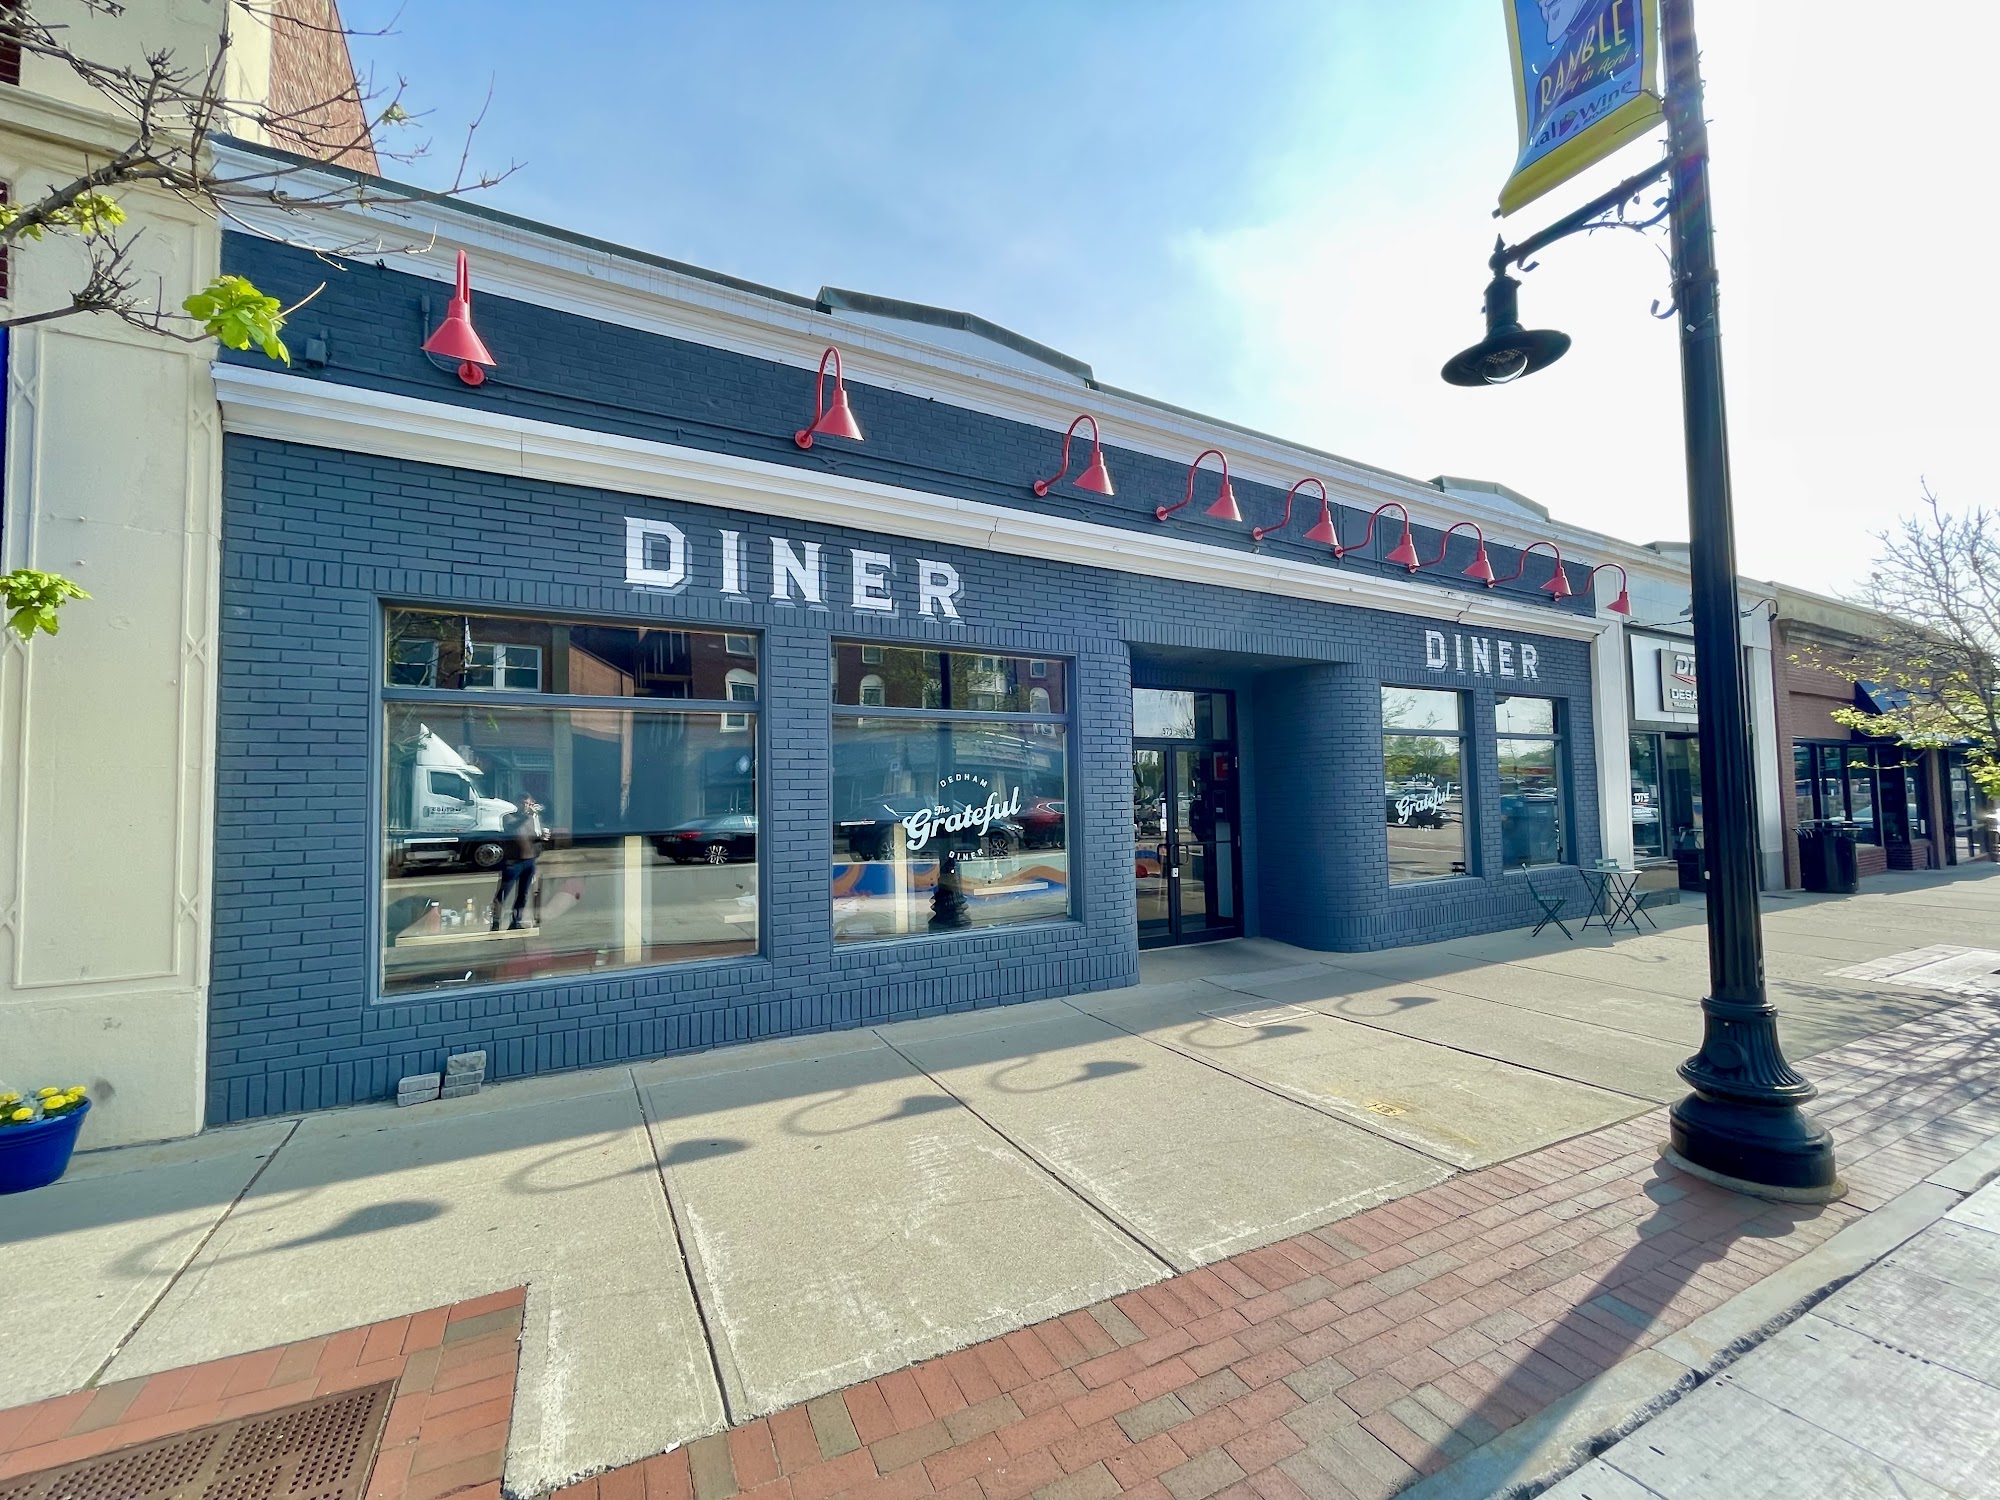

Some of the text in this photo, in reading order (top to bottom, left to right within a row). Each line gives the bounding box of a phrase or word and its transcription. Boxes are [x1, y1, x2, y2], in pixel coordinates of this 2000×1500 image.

[1540, 0, 1627, 113] RAMBLE
[624, 516, 965, 625] DINER
[1425, 630, 1540, 681] DINER
[940, 773, 988, 788] DEDHAM
[1395, 781, 1451, 825] Grateful
[902, 786, 1022, 850] Grateful
[934, 804, 951, 816] The
[949, 848, 984, 861] DINER
